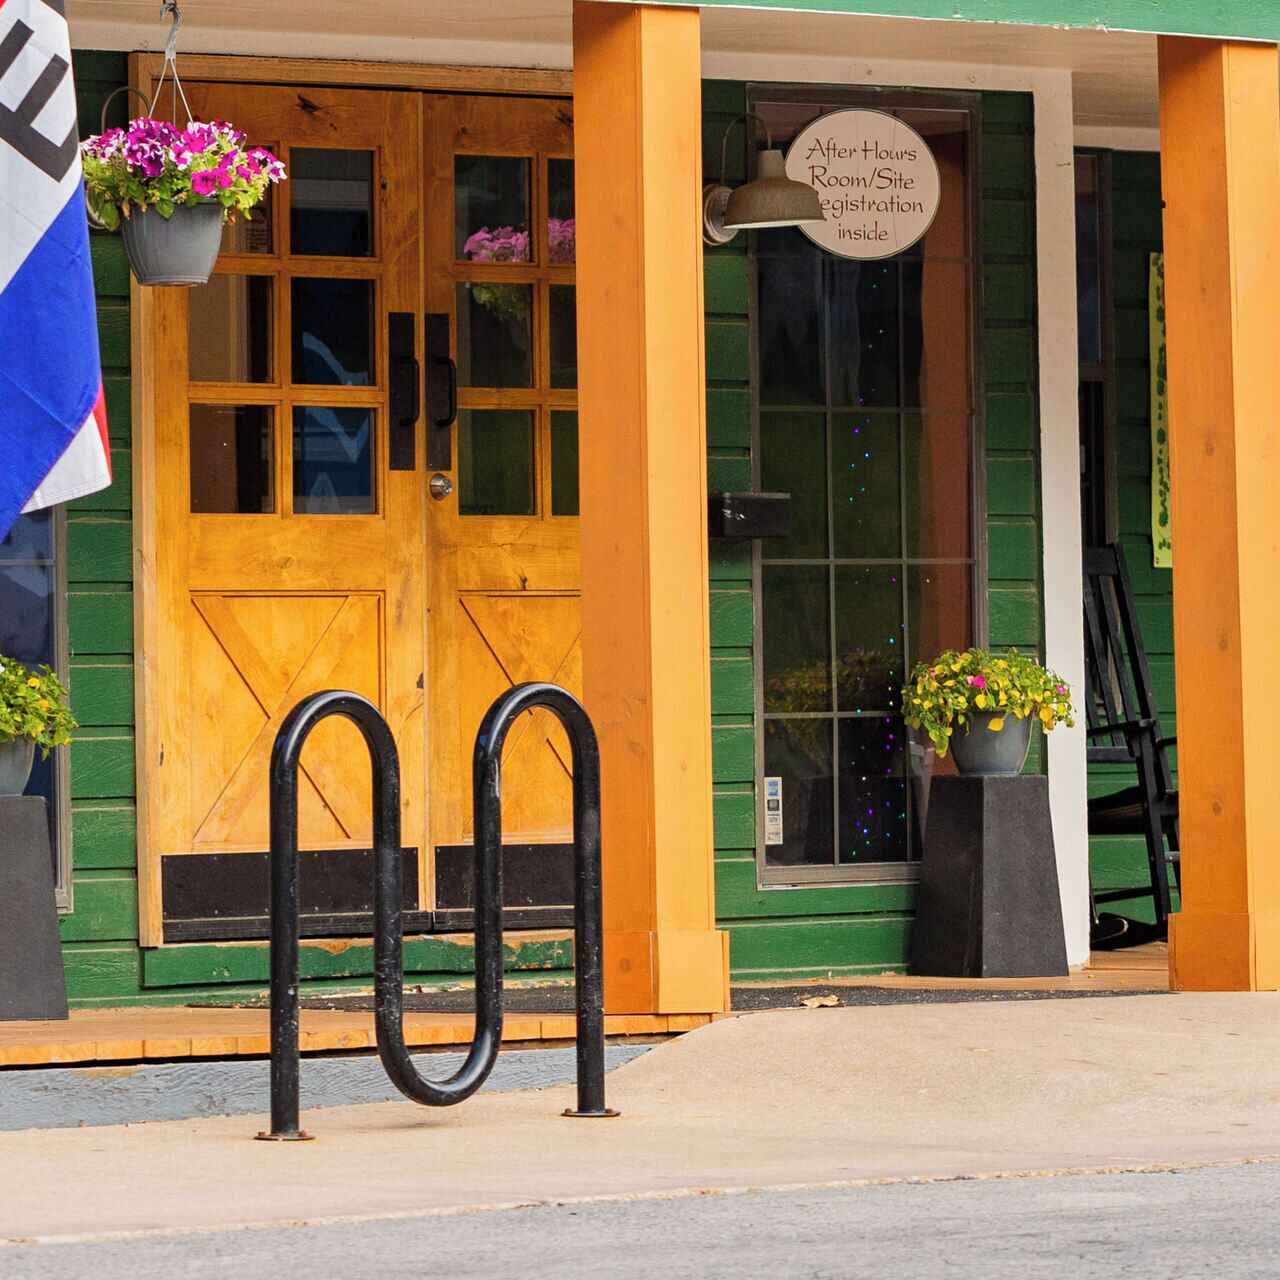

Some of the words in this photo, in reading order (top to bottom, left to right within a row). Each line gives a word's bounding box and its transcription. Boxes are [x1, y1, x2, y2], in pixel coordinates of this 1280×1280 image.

[806, 138, 856, 165] After
[862, 141, 917, 161] Hours
[808, 165, 915, 189] Room/Site
[816, 191, 923, 219] egistration
[838, 221, 888, 241] inside
